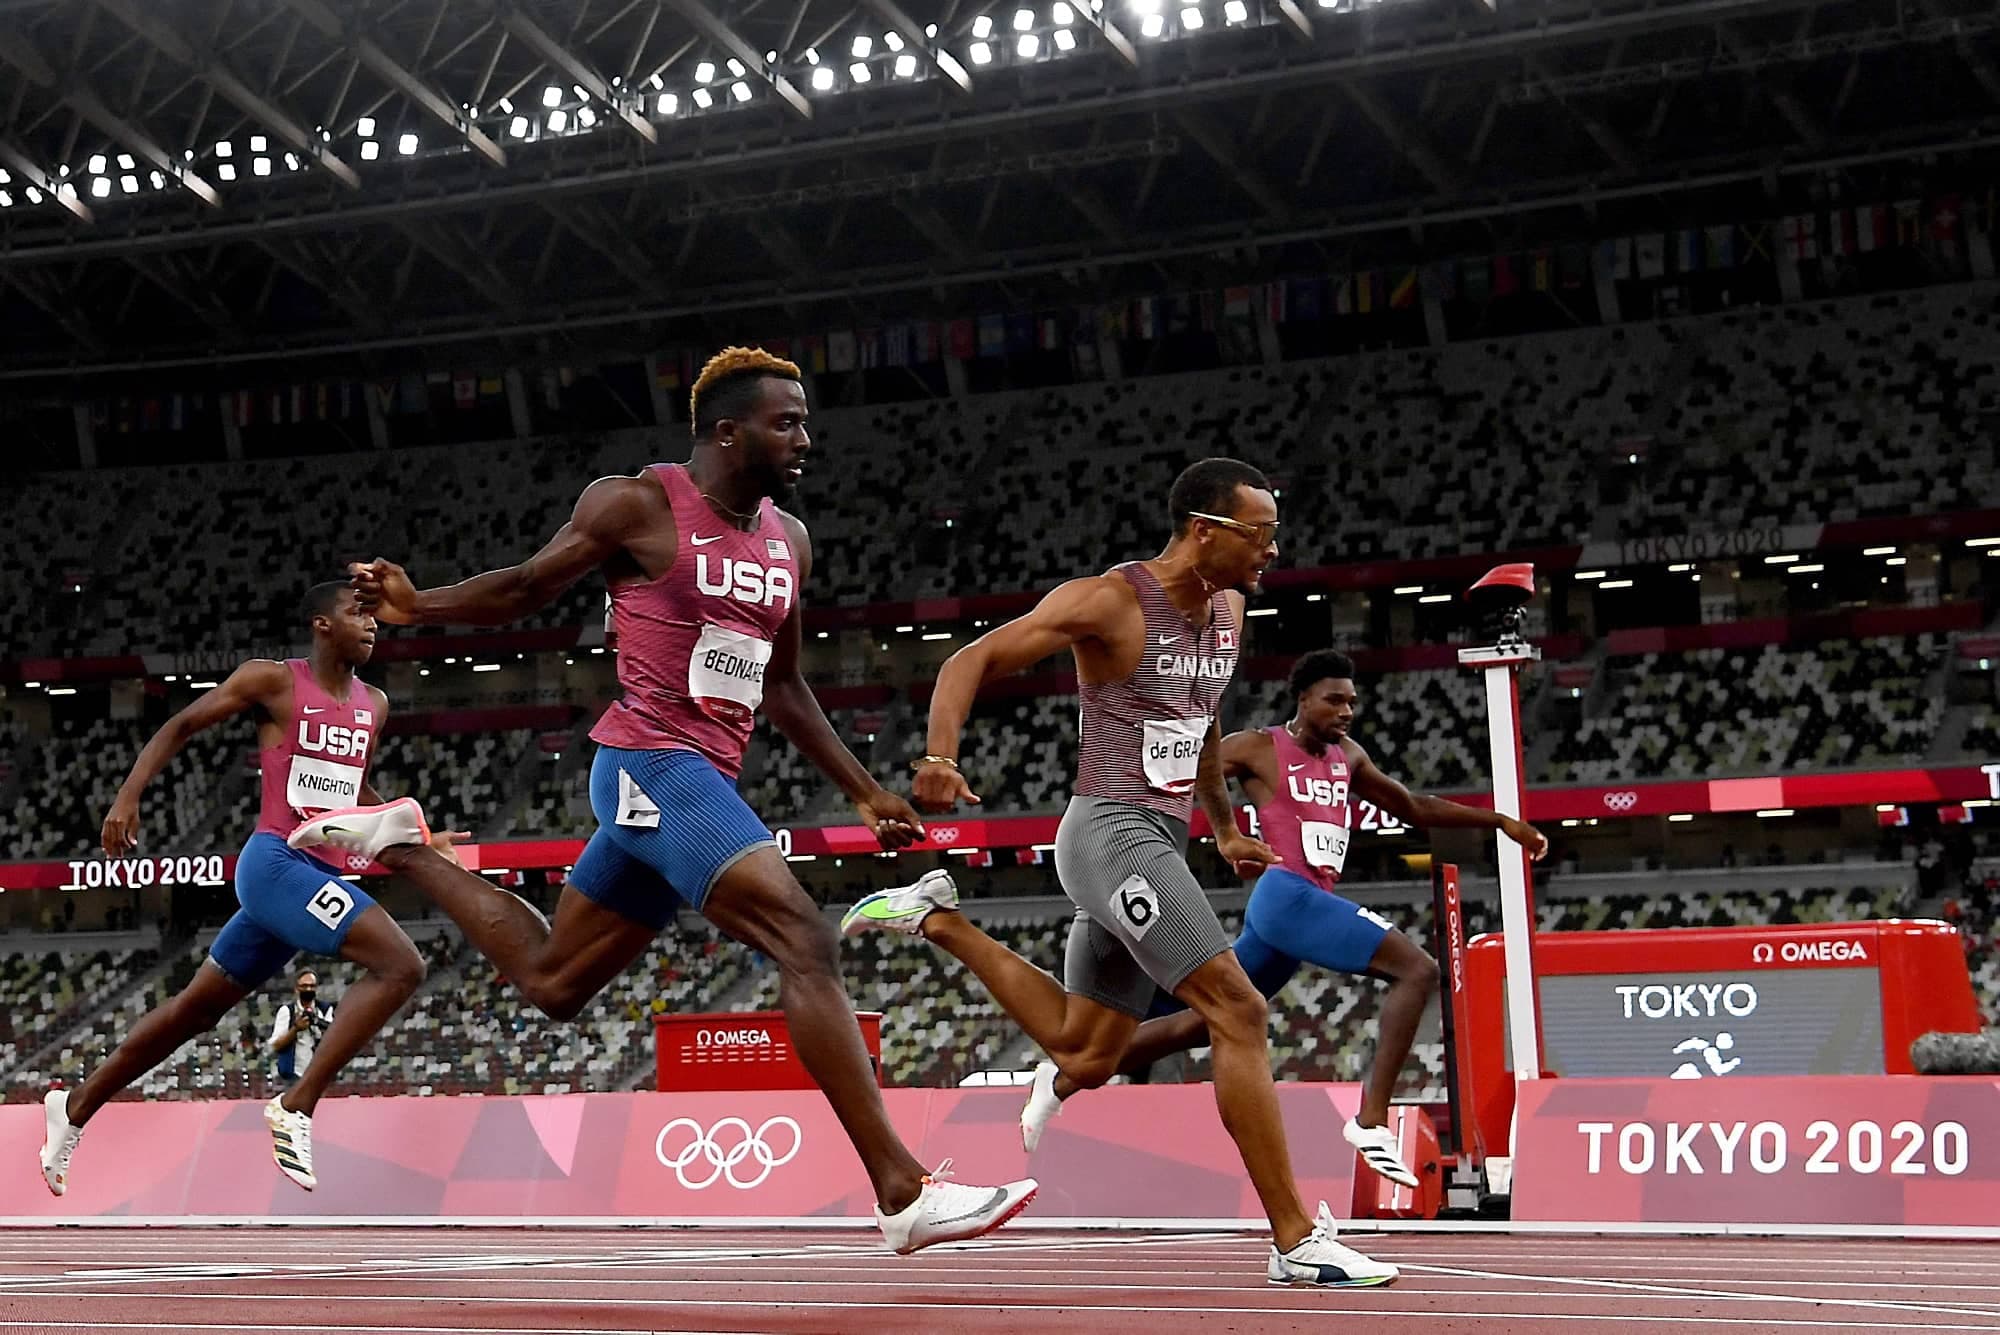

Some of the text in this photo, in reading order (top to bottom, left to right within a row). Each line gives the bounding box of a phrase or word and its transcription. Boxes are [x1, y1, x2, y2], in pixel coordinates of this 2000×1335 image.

[696, 554, 793, 609] USA
[1156, 654, 1235, 678] CANADA
[298, 720, 370, 760] USA
[1150, 741, 1168, 759] de
[297, 772, 355, 796] KNIGHTON
[1288, 775, 1349, 807] USA
[69, 855, 225, 888] TOKYO 2020
[315, 890, 346, 918] 5
[1121, 889, 1153, 927] 6
[1449, 910, 1462, 993] OMEGA
[1780, 940, 1868, 962] OMEGA
[1615, 983, 1758, 1018] TOKYO
[714, 1029, 771, 1045] OMEGA
[1578, 1120, 1968, 1175] TOKYO 2020
